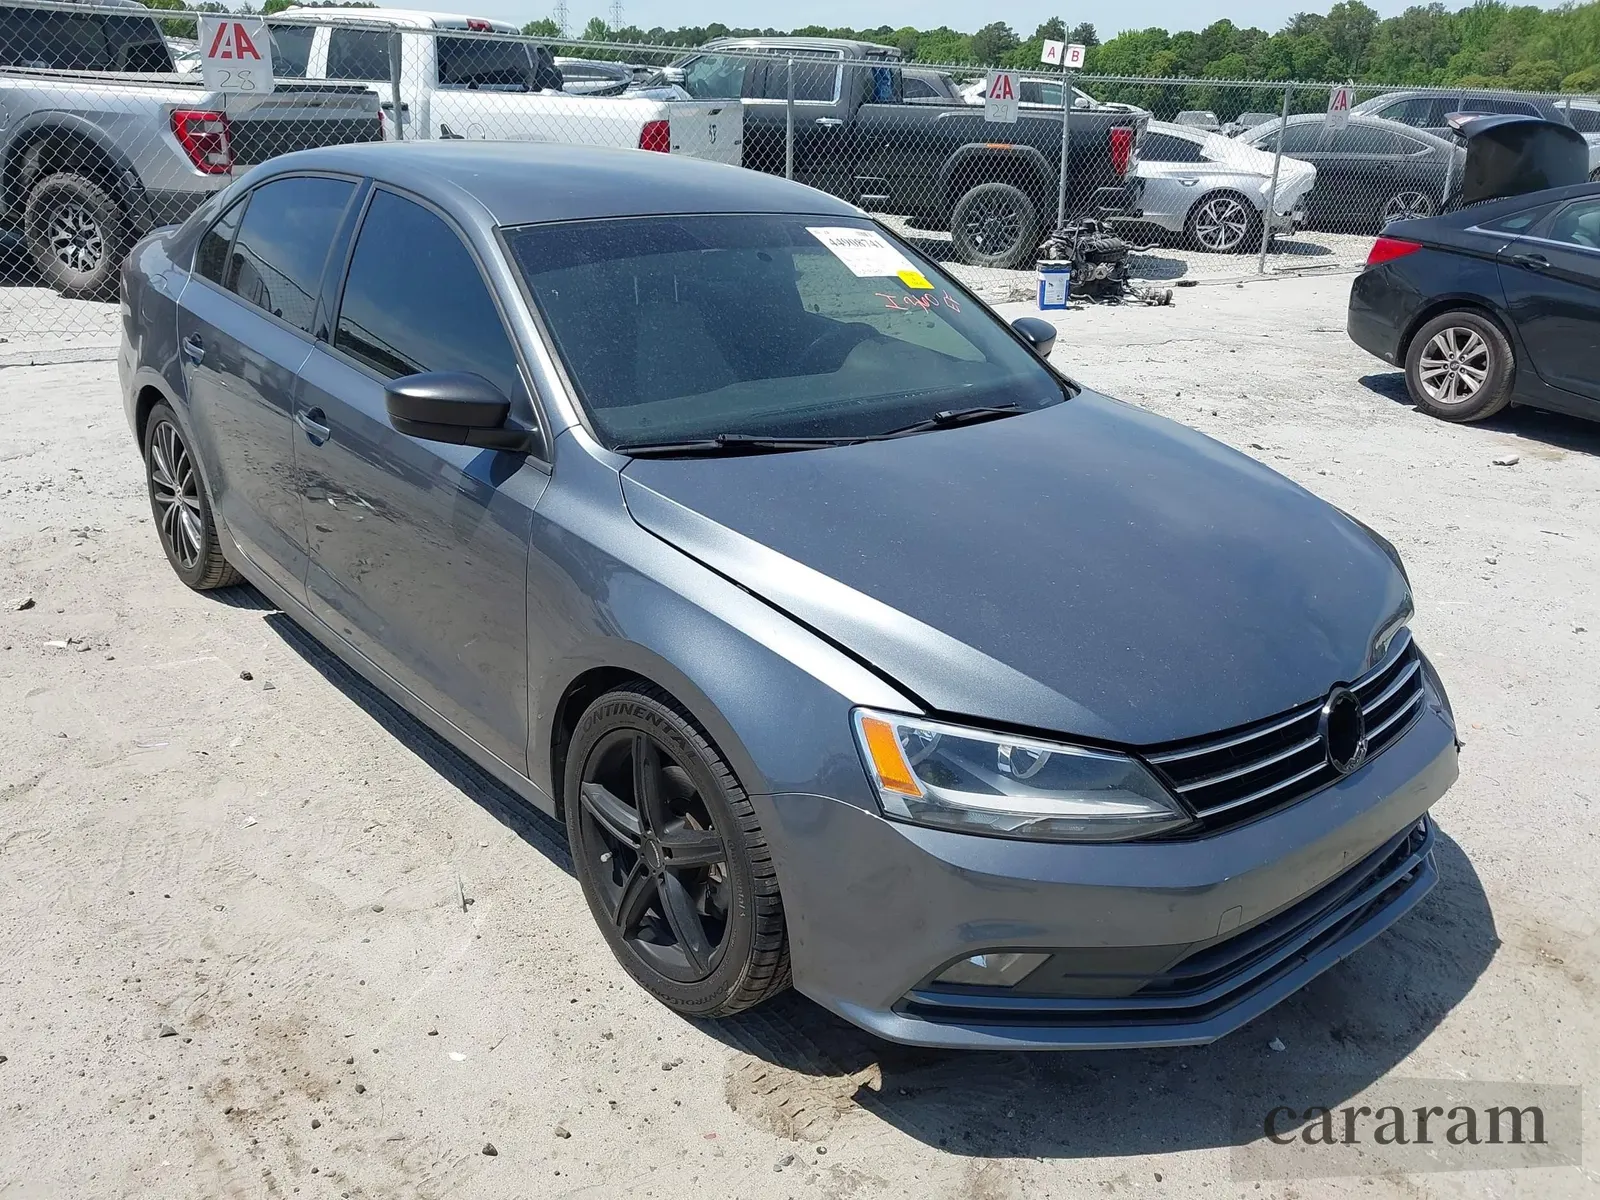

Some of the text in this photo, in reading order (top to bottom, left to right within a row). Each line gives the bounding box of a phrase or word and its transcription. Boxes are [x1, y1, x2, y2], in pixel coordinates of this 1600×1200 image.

[1047, 46, 1055, 58] A
[1071, 50, 1080, 62] B
[217, 69, 255, 90] 28
[990, 103, 1009, 119] 29
